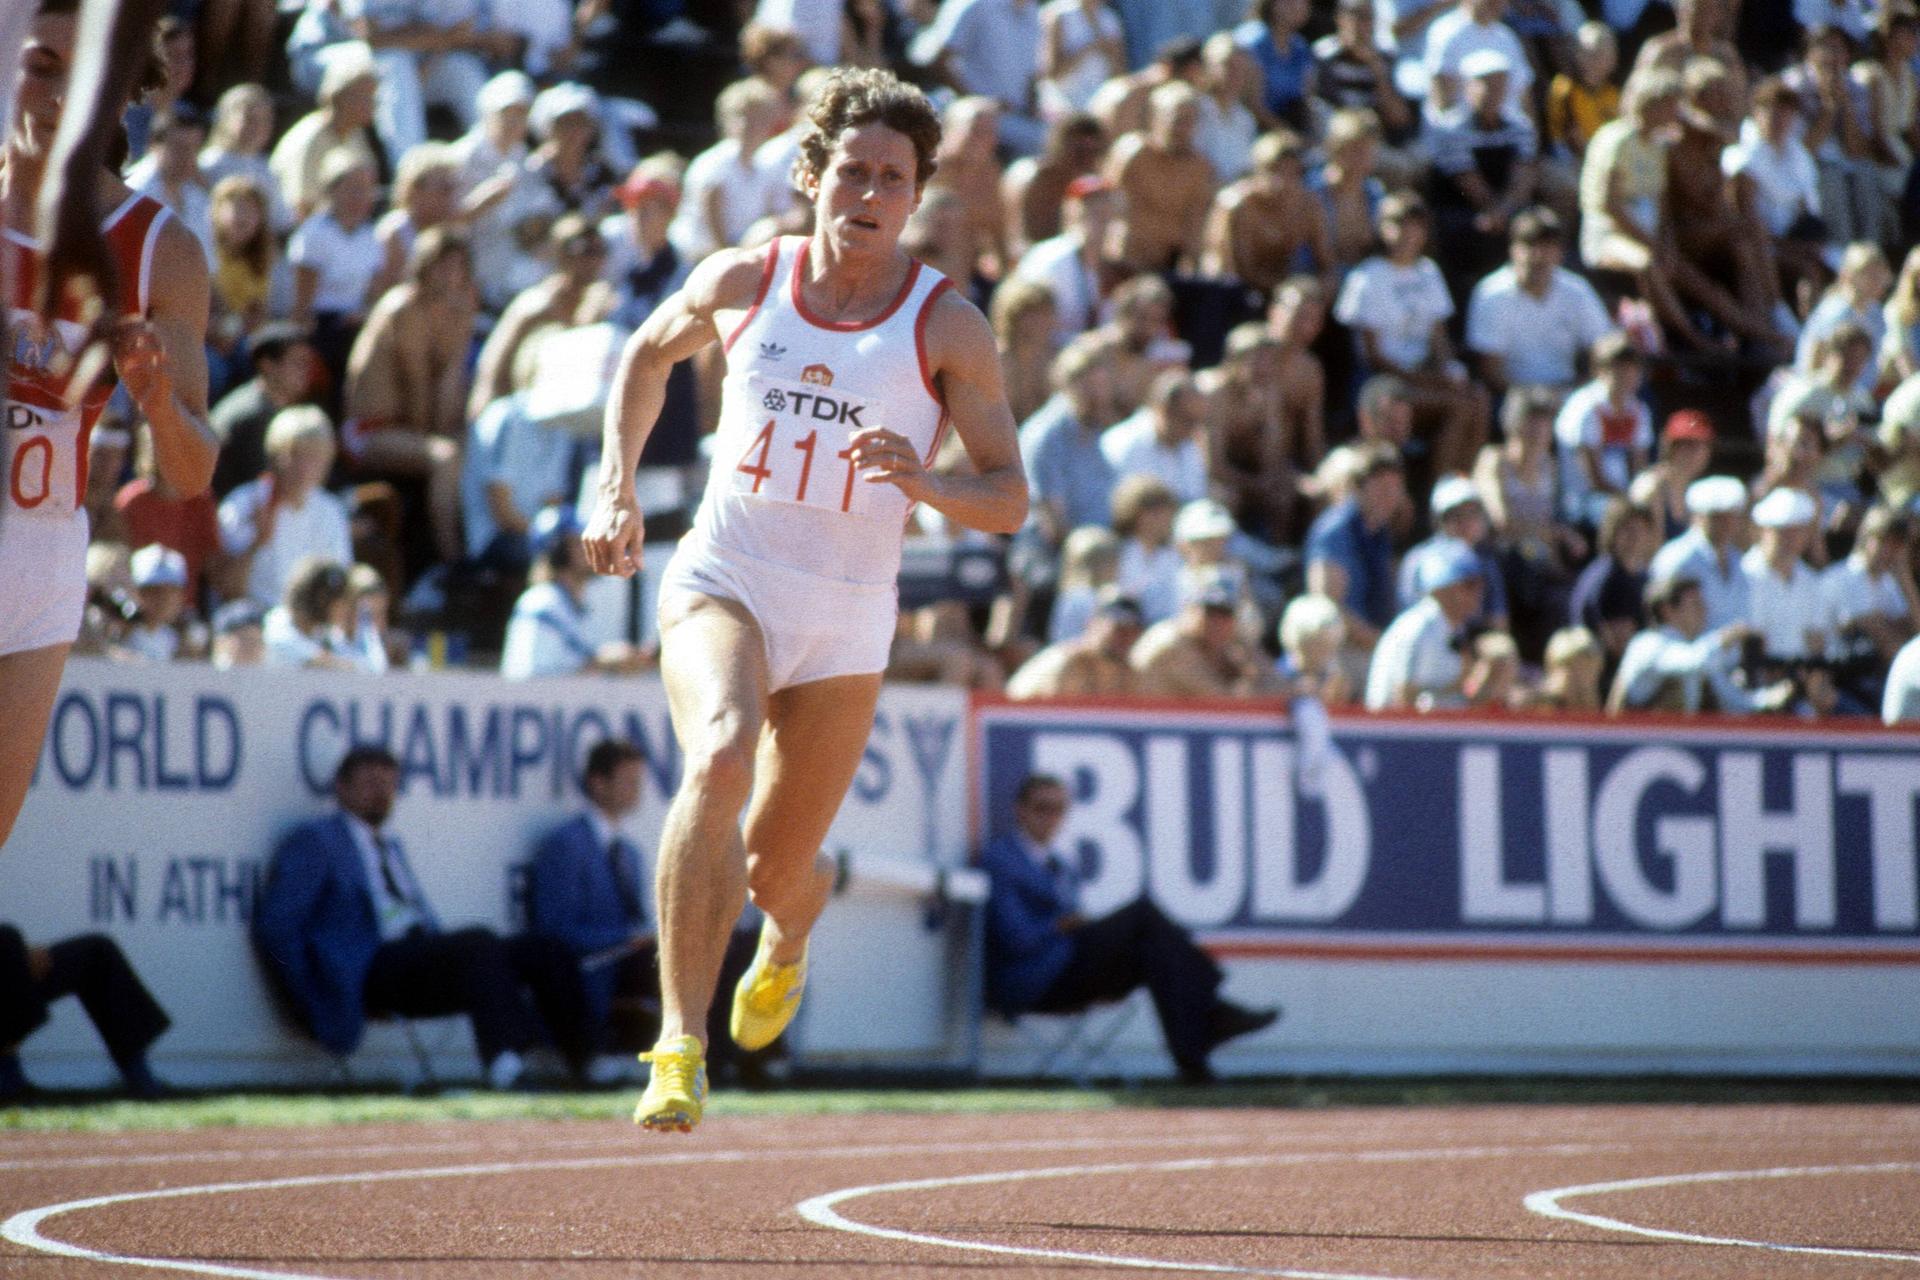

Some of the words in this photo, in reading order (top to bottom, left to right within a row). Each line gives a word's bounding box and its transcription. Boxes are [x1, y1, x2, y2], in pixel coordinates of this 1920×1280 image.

[786, 391, 865, 428] TDK
[30, 693, 242, 791] ORLD
[1033, 733, 1373, 927] BUD
[1457, 745, 1920, 931] LIGHT
[91, 856, 136, 922] IN
